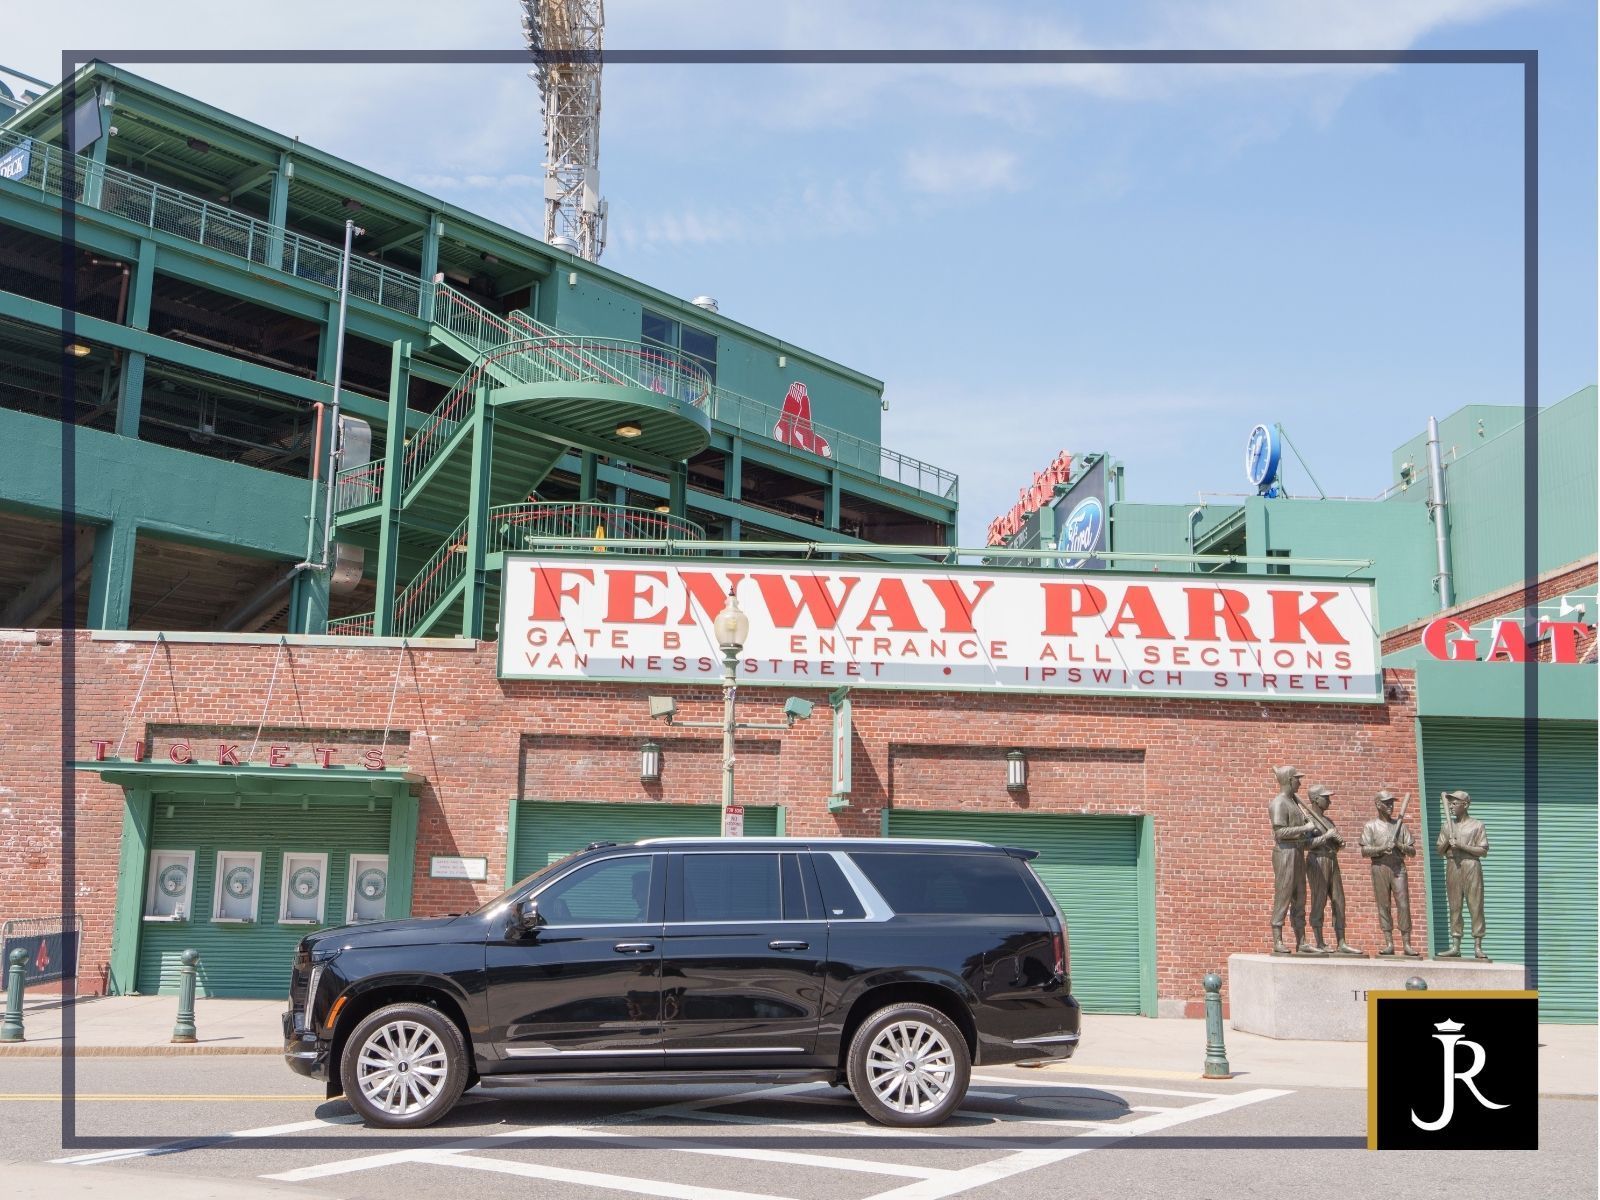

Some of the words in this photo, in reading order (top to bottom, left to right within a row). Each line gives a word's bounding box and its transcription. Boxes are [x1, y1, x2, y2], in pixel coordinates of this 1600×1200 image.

[528, 567, 995, 634] FENWAY
[1040, 582, 1351, 645] PARK
[526, 627, 629, 649] GATE
[663, 632, 681, 650] B
[790, 635, 1009, 660] ENTRANCE
[1040, 643, 1112, 663] ALL
[1143, 645, 1353, 670] SECTIONS
[525, 651, 588, 668] VAN
[621, 655, 713, 672] NESS
[744, 657, 885, 676] STREET
[1024, 666, 1183, 686] IPSWICH
[1213, 671, 1353, 690] STREET
[91, 740, 385, 770] TICKETS
